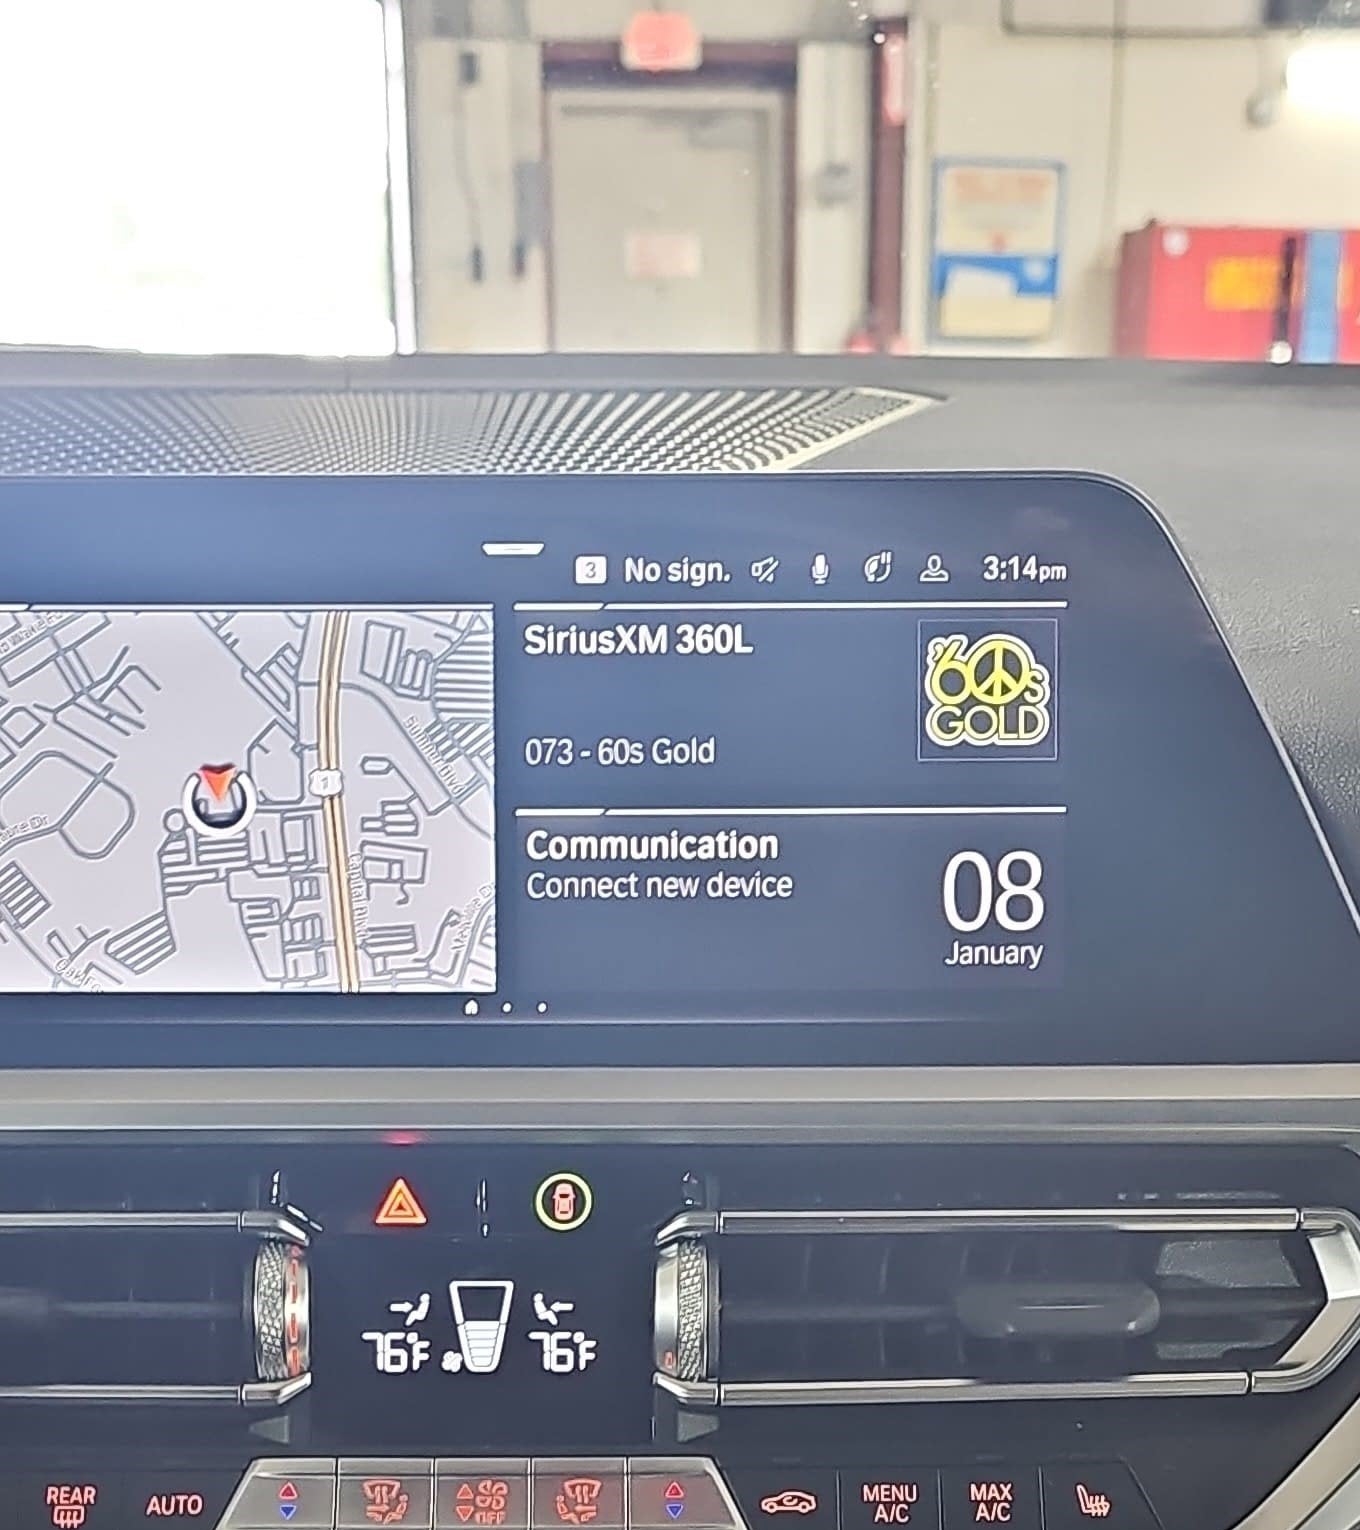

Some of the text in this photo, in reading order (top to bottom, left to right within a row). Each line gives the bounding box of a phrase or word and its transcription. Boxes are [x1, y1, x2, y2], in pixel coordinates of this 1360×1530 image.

[624, 557, 661, 583] No
[666, 556, 732, 588] sign.
[523, 624, 754, 655] SiriusXM 360L
[924, 703, 1051, 747] GOLD
[524, 738, 573, 766] 073
[597, 738, 644, 765] 60s
[651, 735, 716, 765] Gold
[526, 830, 780, 862] Communication
[526, 870, 794, 900] Connect new device
[943, 850, 1045, 932] 08
[944, 941, 1044, 970] January
[46, 1486, 96, 1505] REAR
[146, 1494, 204, 1516] AUTO
[862, 1483, 918, 1503] MENU
[970, 1482, 1015, 1503] MAX
[874, 1503, 910, 1525] A/C
[975, 1502, 1013, 1524] A/C
